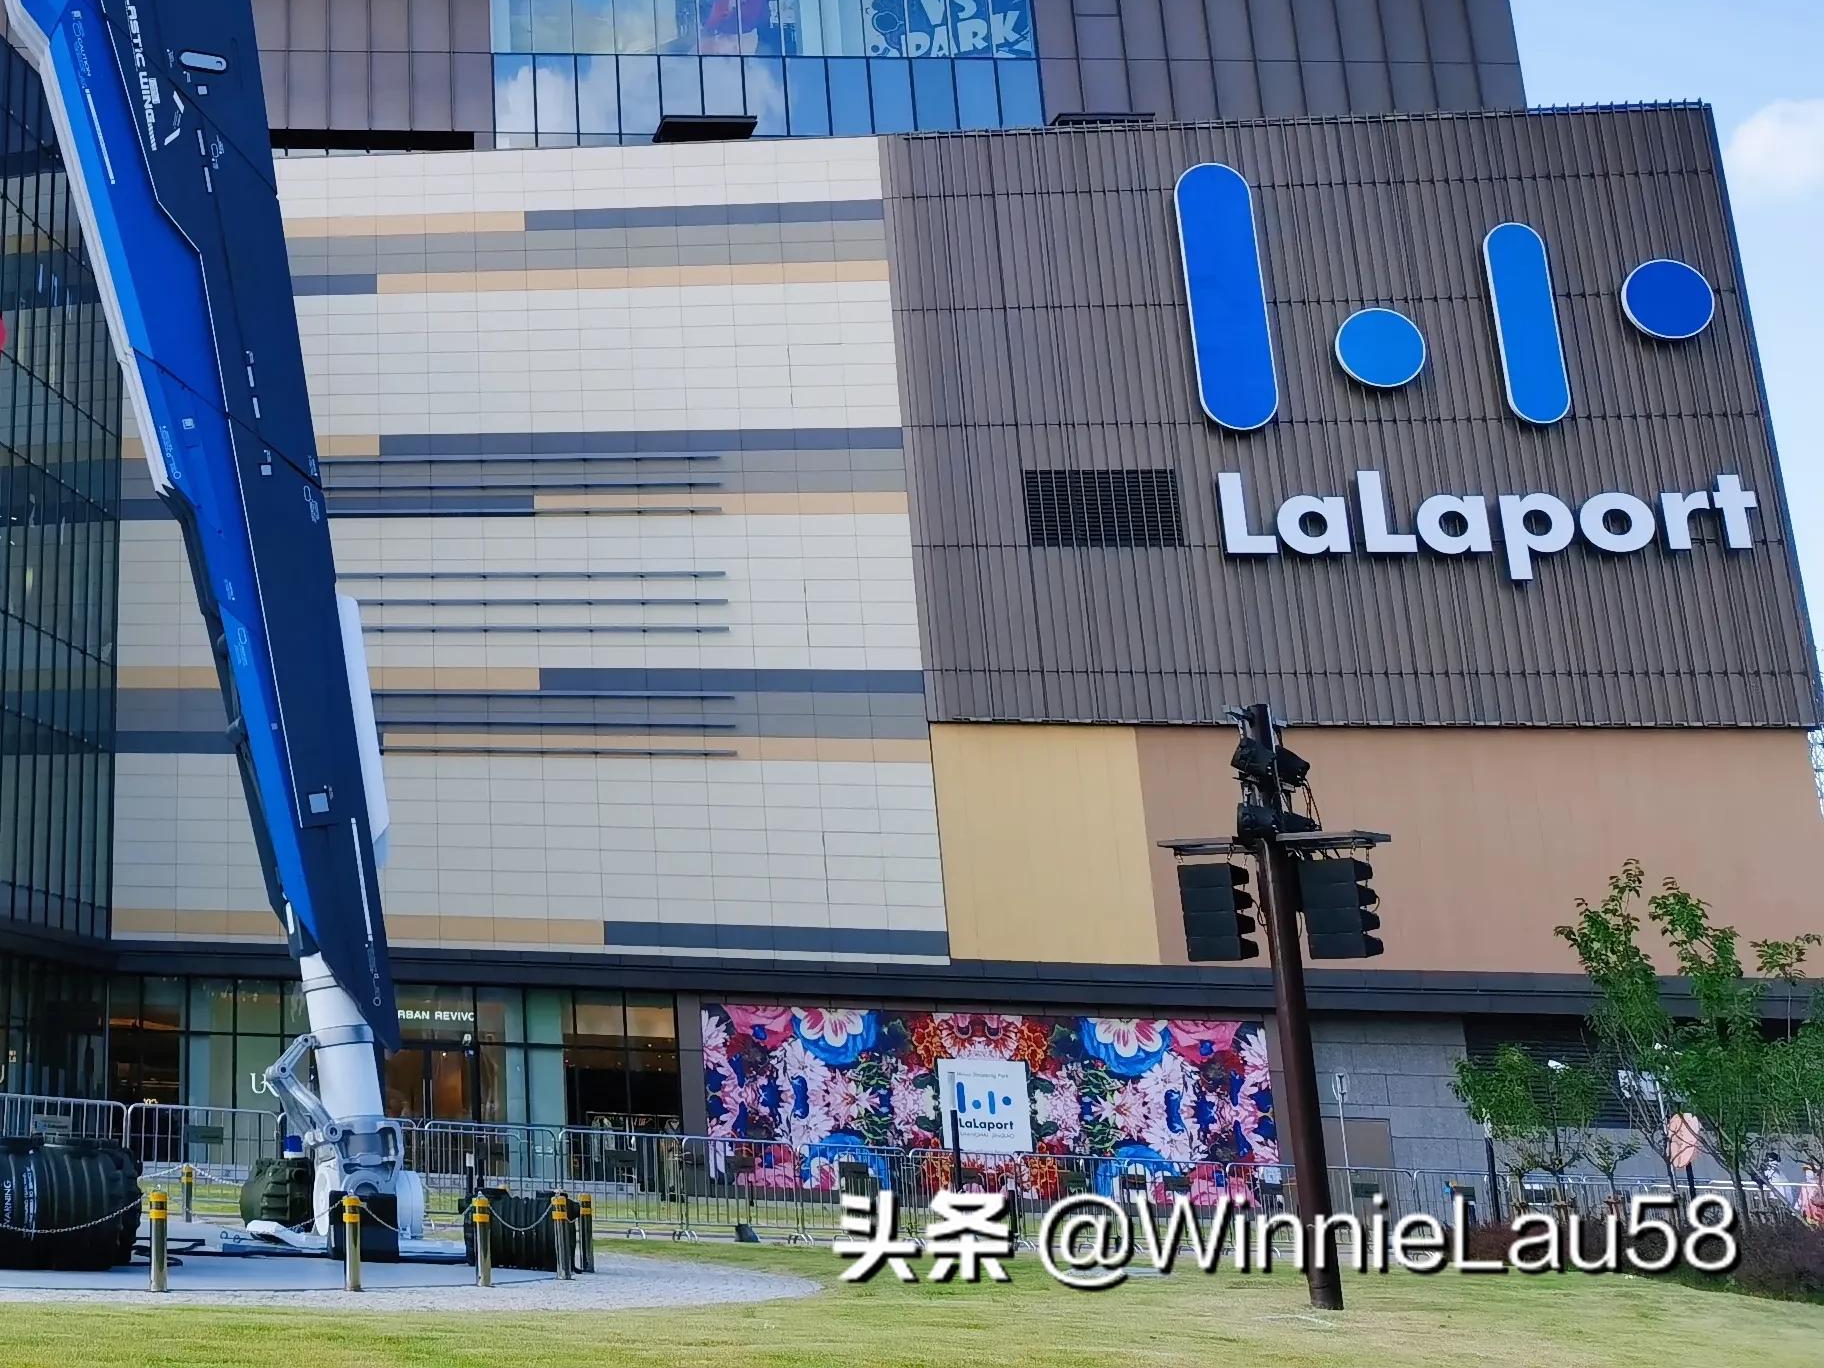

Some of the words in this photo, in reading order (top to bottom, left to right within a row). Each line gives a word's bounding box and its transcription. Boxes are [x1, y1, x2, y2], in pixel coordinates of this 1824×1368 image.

[900, 11, 1020, 57] PARK
[138, 71, 155, 123] WING
[1217, 470, 1758, 581] LaLaport
[397, 1010, 430, 1020] RBAN
[959, 1118, 1014, 1131] LaLaport
